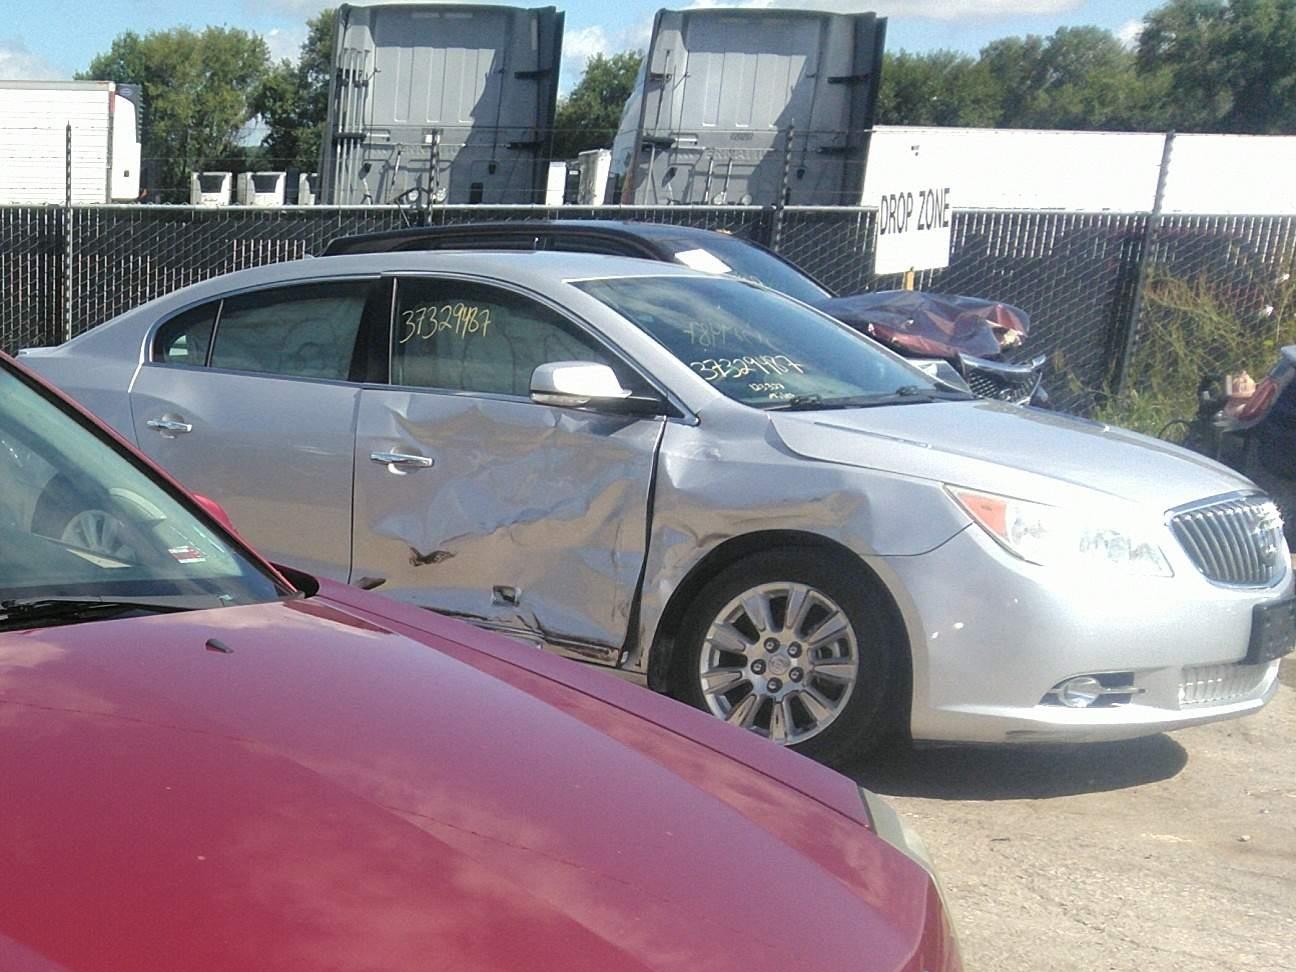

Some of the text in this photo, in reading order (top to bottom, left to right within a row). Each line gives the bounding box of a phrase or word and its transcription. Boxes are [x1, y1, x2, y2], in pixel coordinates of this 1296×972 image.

[880, 187, 951, 235] DROP ZONE
[399, 302, 492, 344] 37329487
